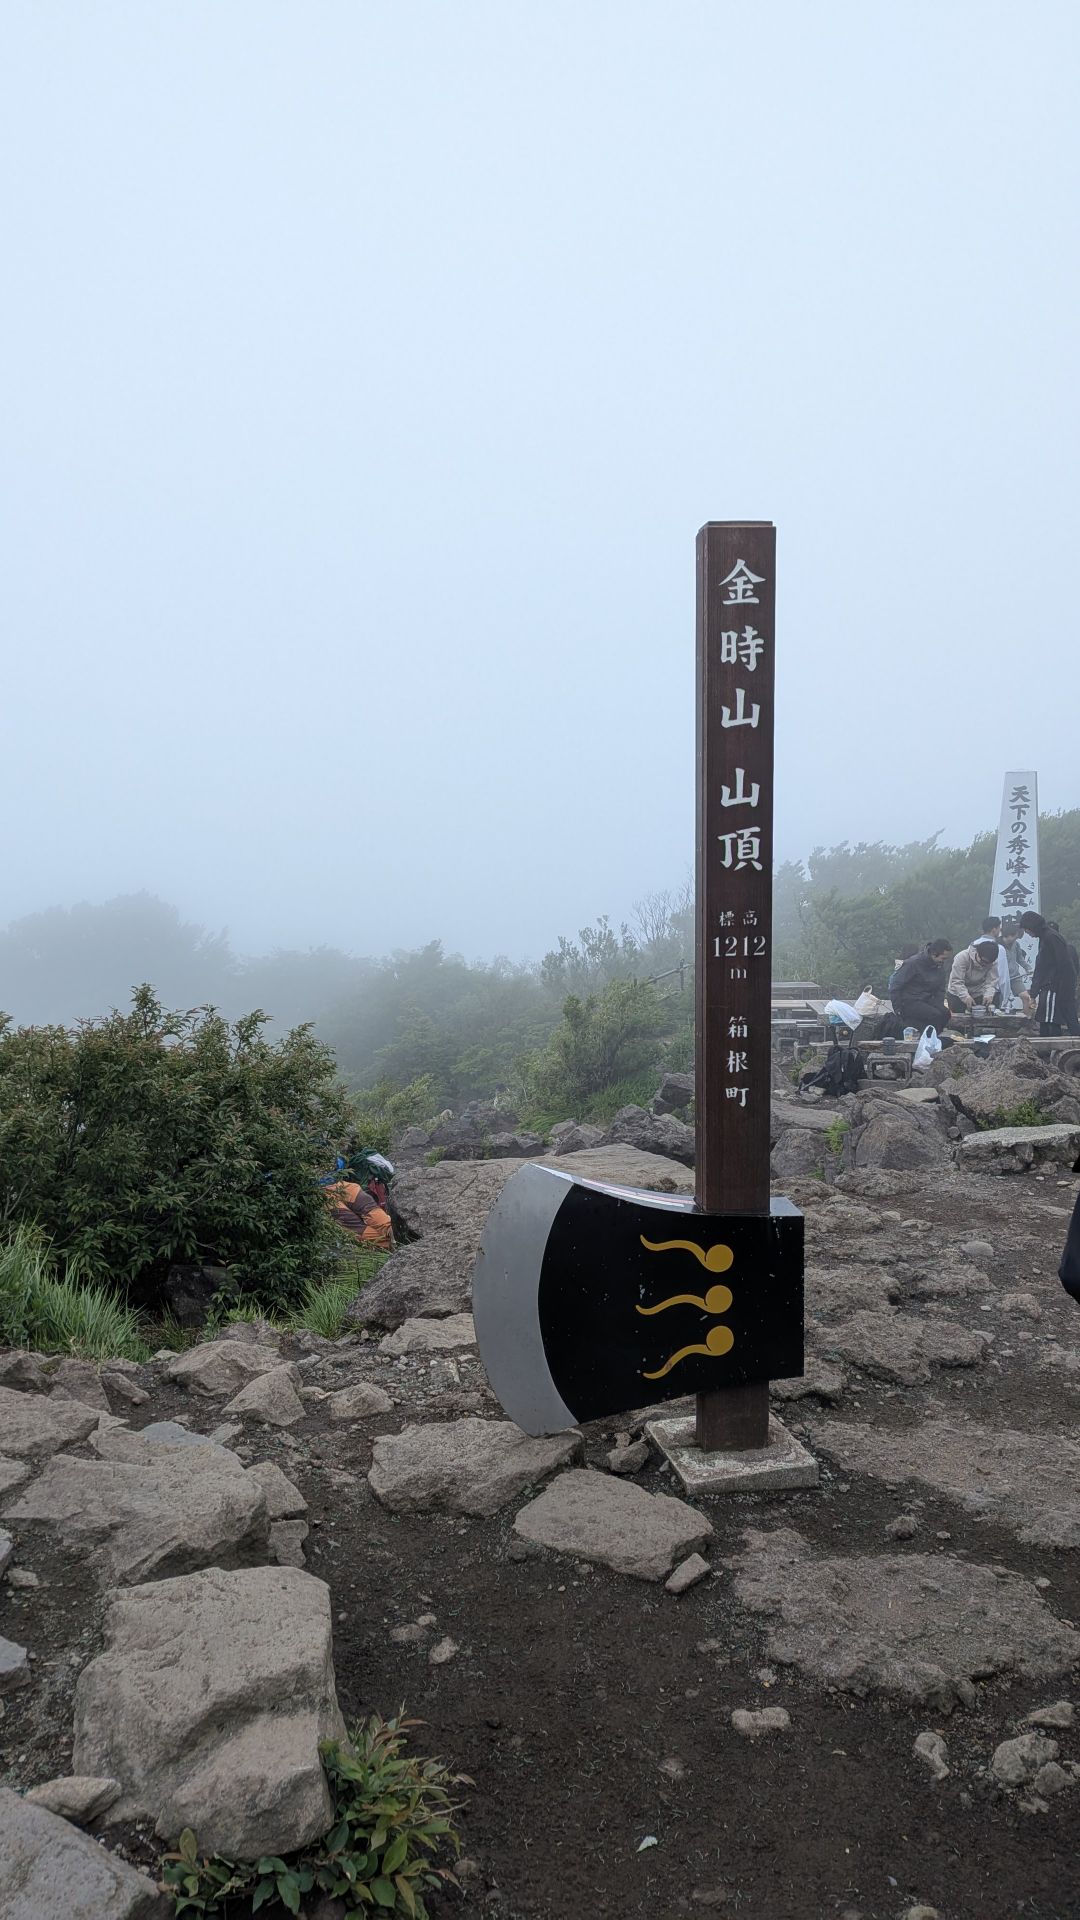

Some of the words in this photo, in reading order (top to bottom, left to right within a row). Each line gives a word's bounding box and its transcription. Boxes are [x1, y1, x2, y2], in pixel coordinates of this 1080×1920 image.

[718, 558, 766, 728] 金時山
[717, 767, 763, 871] 山頂
[711, 936, 766, 957] 1212
[719, 909, 758, 926] 標高
[724, 1015, 750, 1107] 箱根町
